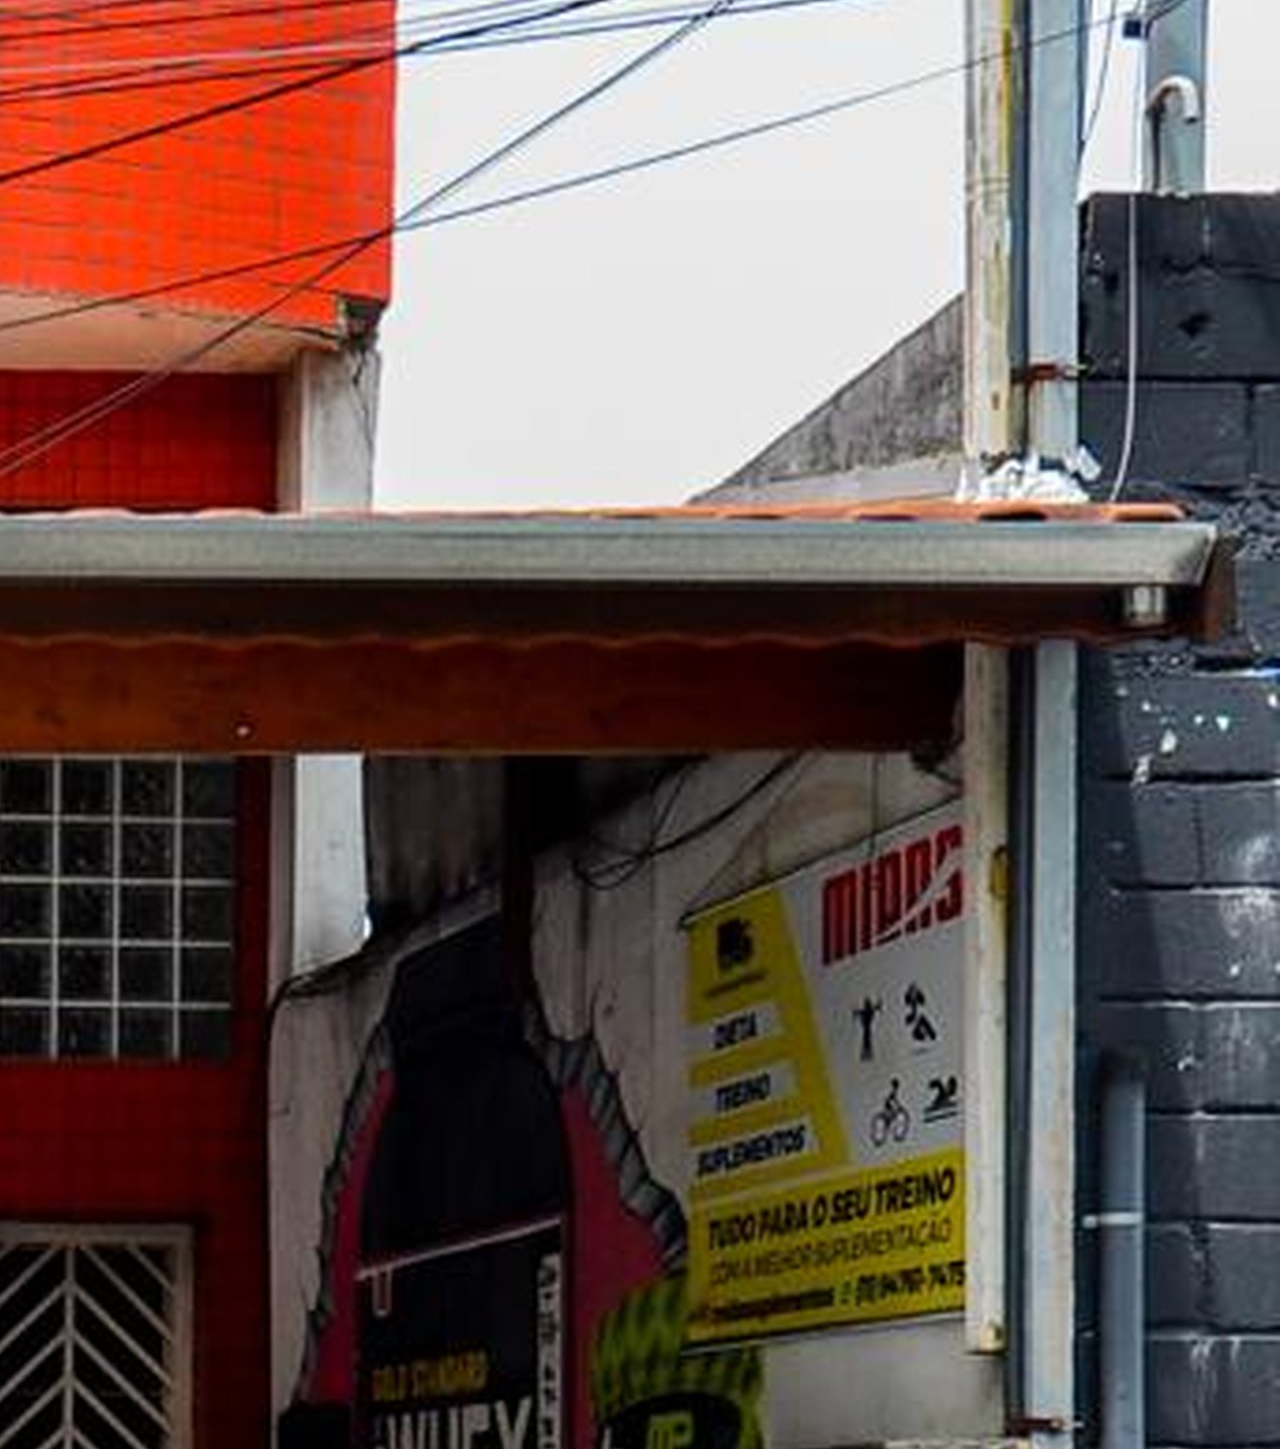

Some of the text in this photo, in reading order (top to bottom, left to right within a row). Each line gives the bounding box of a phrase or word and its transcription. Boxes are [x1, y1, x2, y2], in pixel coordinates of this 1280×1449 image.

[822, 823, 964, 966] MIDAS
[708, 1166, 956, 1251] TUDO PARA O SEU TREINO
